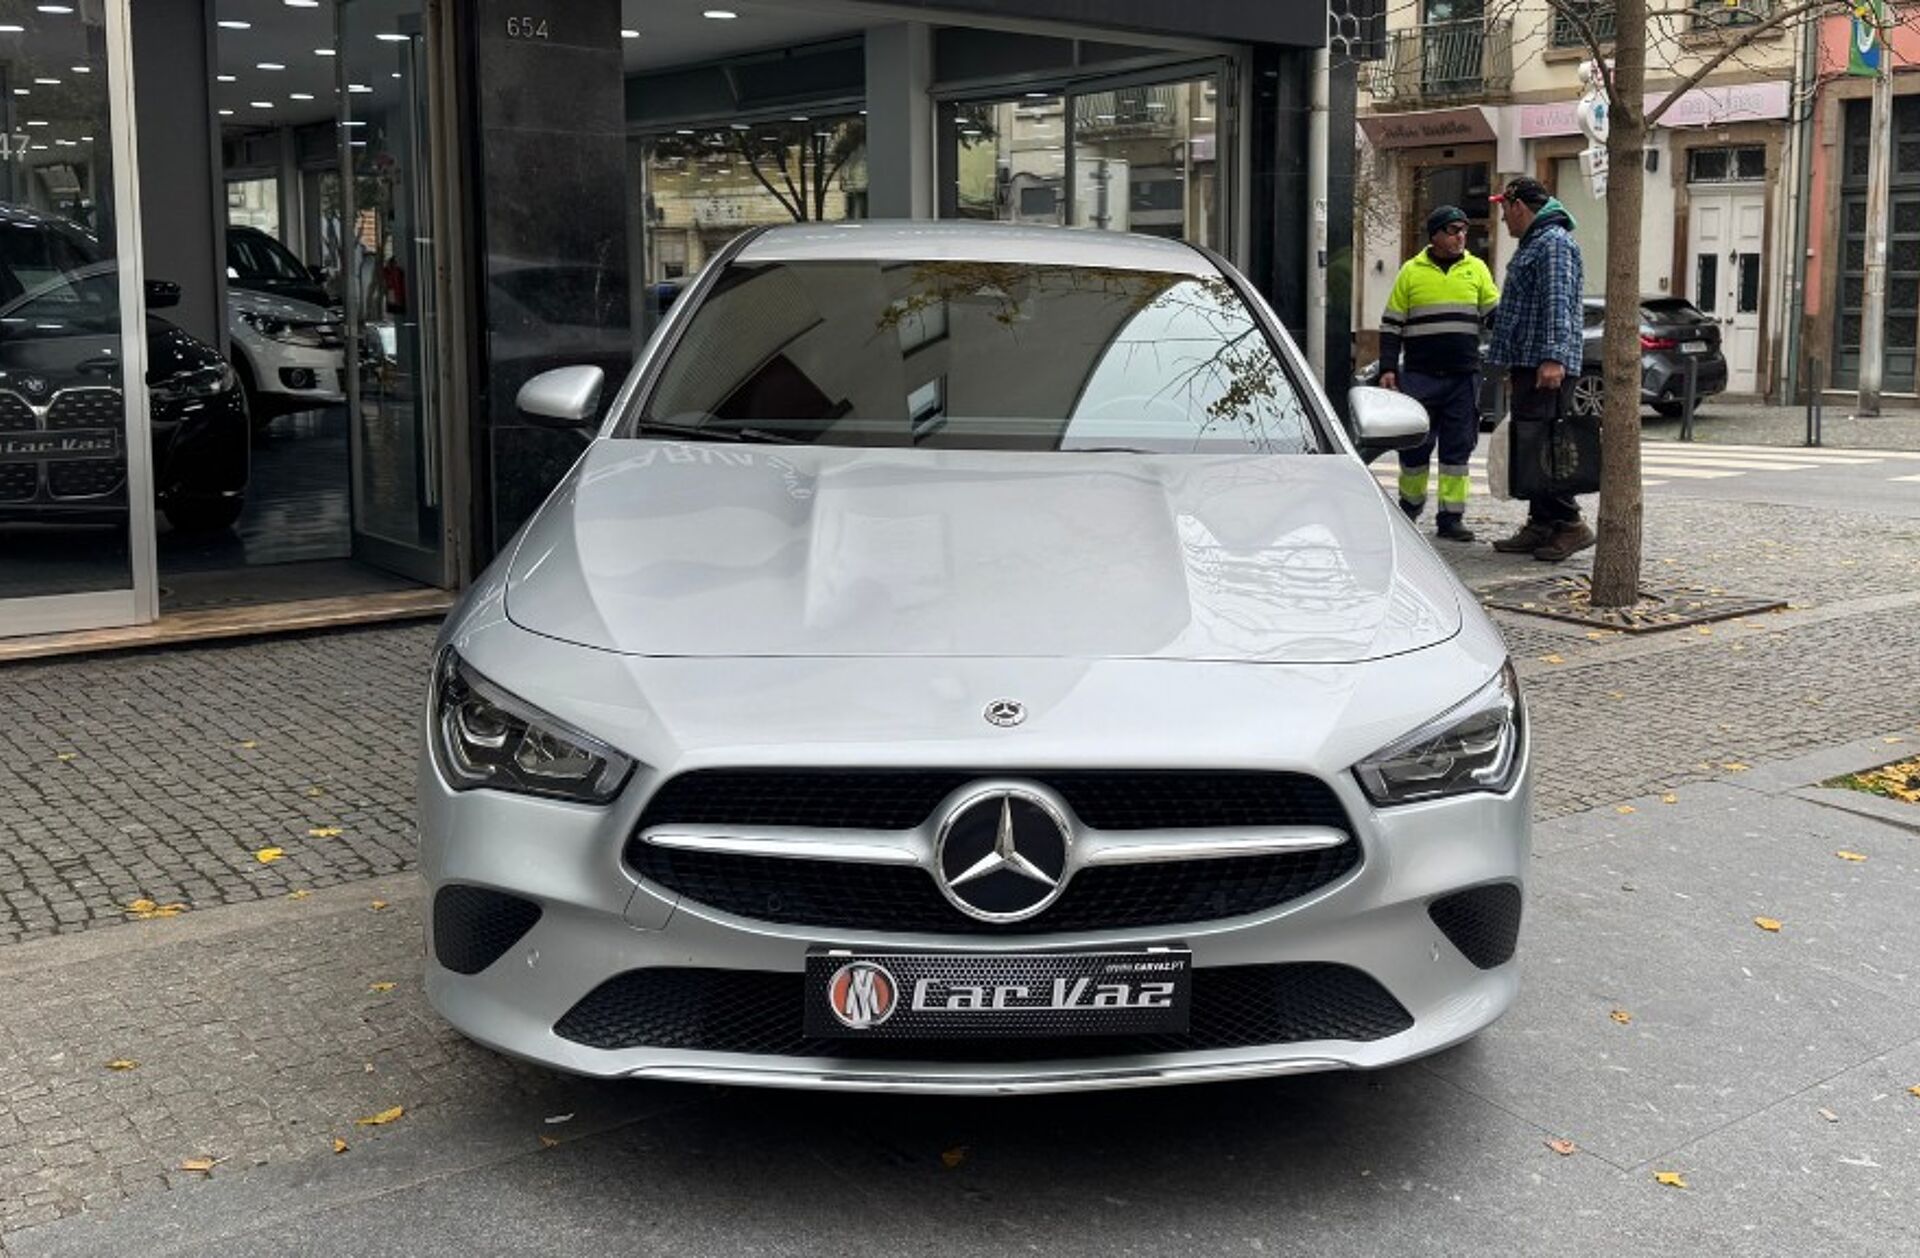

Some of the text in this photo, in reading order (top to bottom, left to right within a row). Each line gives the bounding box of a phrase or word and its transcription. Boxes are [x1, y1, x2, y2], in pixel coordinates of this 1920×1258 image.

[507, 16, 549, 40] 654
[911, 977, 1175, 1011] Car Vaz
